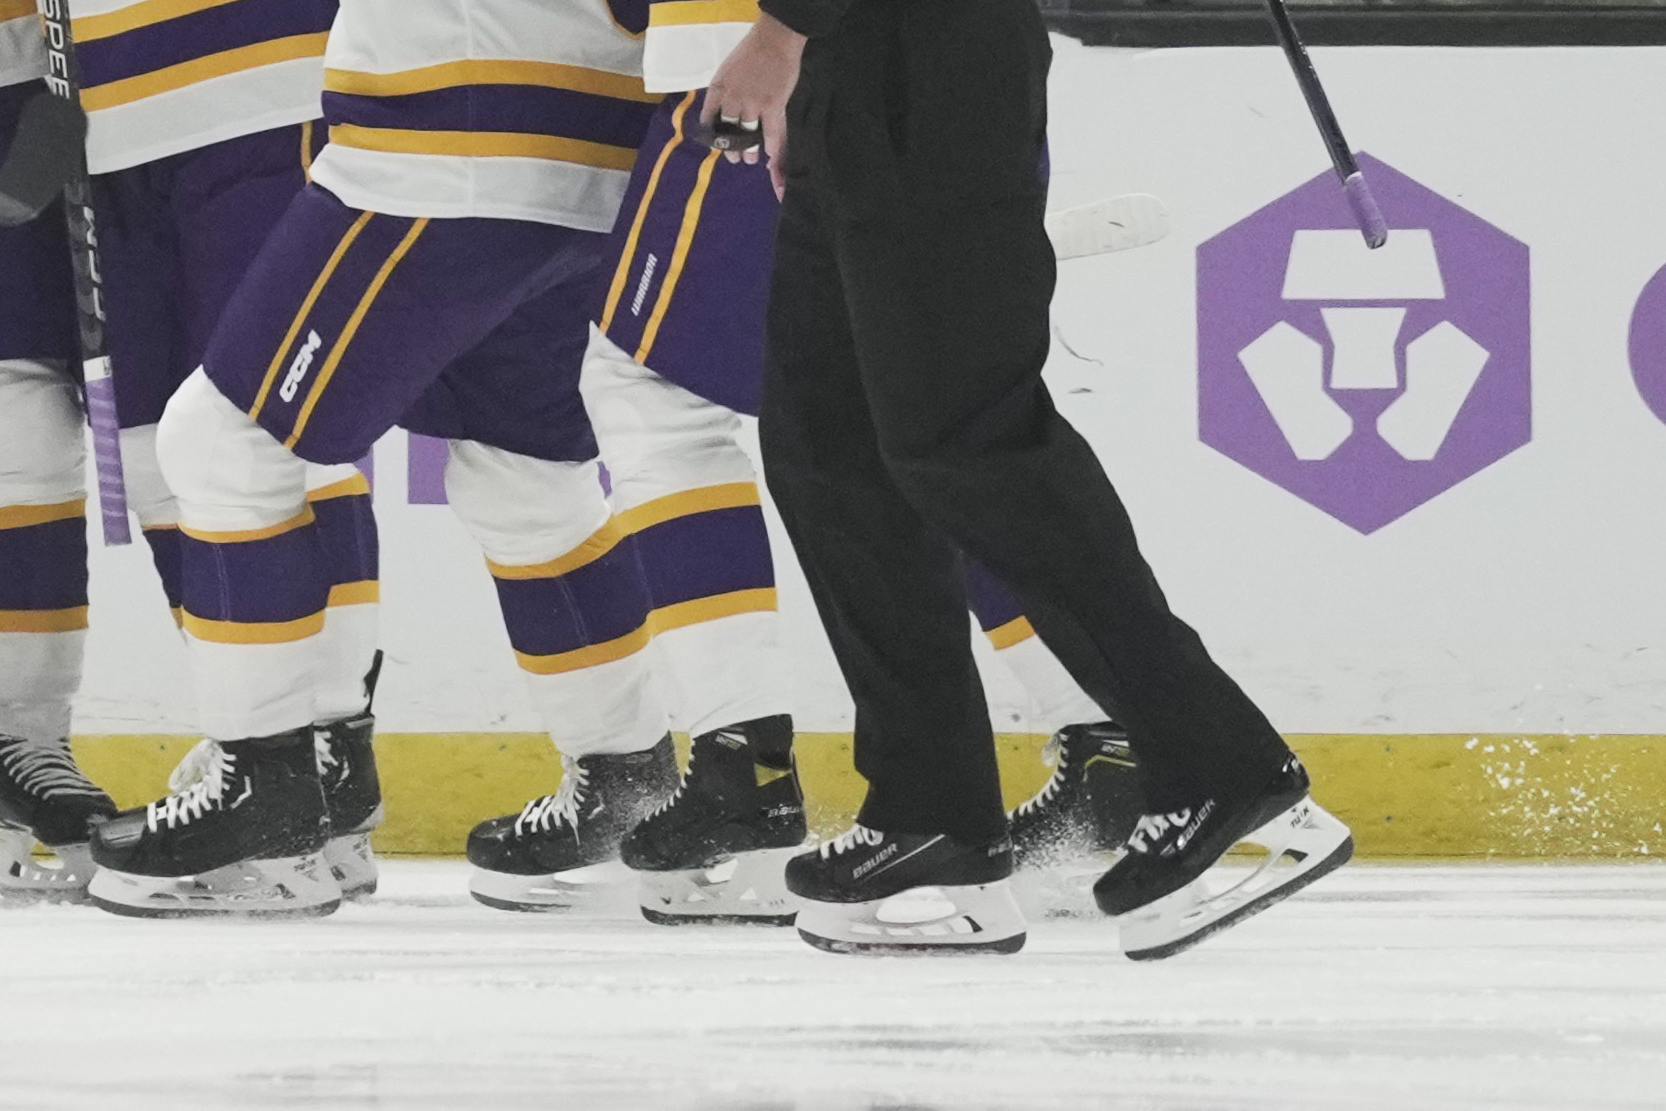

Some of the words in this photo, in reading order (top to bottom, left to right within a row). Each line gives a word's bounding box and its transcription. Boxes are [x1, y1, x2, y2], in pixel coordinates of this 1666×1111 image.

[630, 252, 658, 317] WARRIOR
[278, 329, 322, 403] CCM
[853, 843, 898, 880] BAUER
